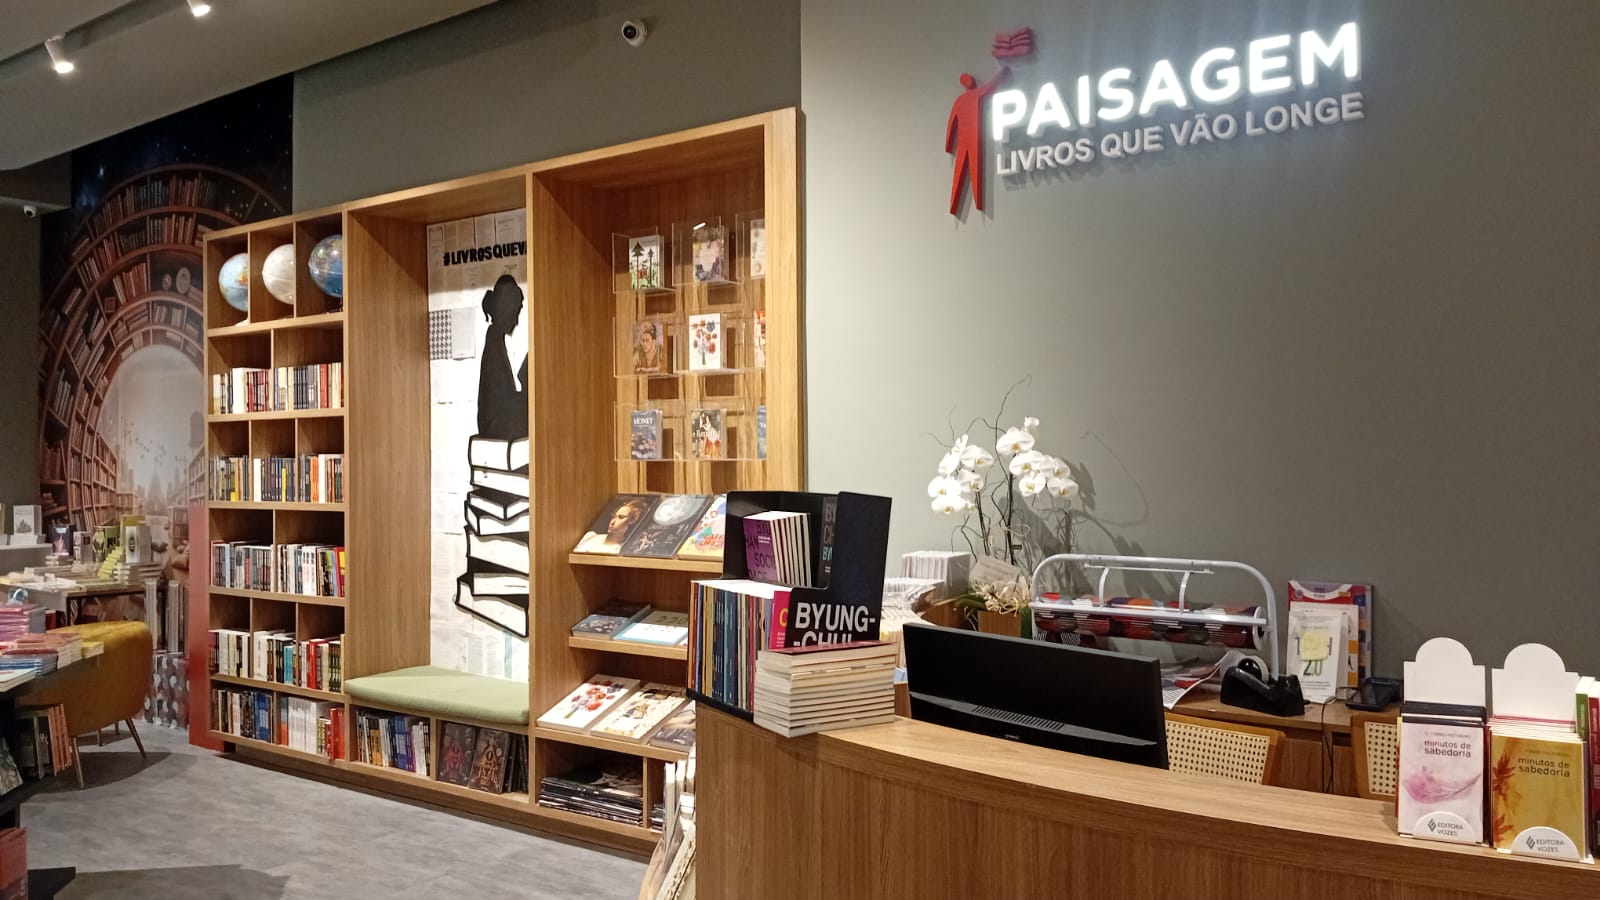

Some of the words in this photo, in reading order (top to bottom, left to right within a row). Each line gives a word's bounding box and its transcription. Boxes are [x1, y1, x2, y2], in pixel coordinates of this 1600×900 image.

[992, 22, 1360, 142] PAISAGEM
[996, 139, 1094, 175] LIVROS
[1101, 126, 1164, 158] QUE
[1170, 112, 1238, 146] VÃO
[1246, 92, 1364, 136] LONGE
[443, 240, 527, 266] #LIVROSQUEV
[795, 602, 876, 632] BYUNG-
[1424, 740, 1458, 749] minutos
[1460, 742, 1472, 750] de
[1424, 747, 1472, 758] sabedoria
[1518, 757, 1556, 767] minutos
[1557, 760, 1570, 769] de
[1518, 765, 1570, 778] sabedoria
[1437, 822, 1464, 831] EDITORA
[1437, 829, 1458, 837] VOZES
[1536, 839, 1564, 847] EDITORA
[1537, 846, 1560, 854] VOZES
